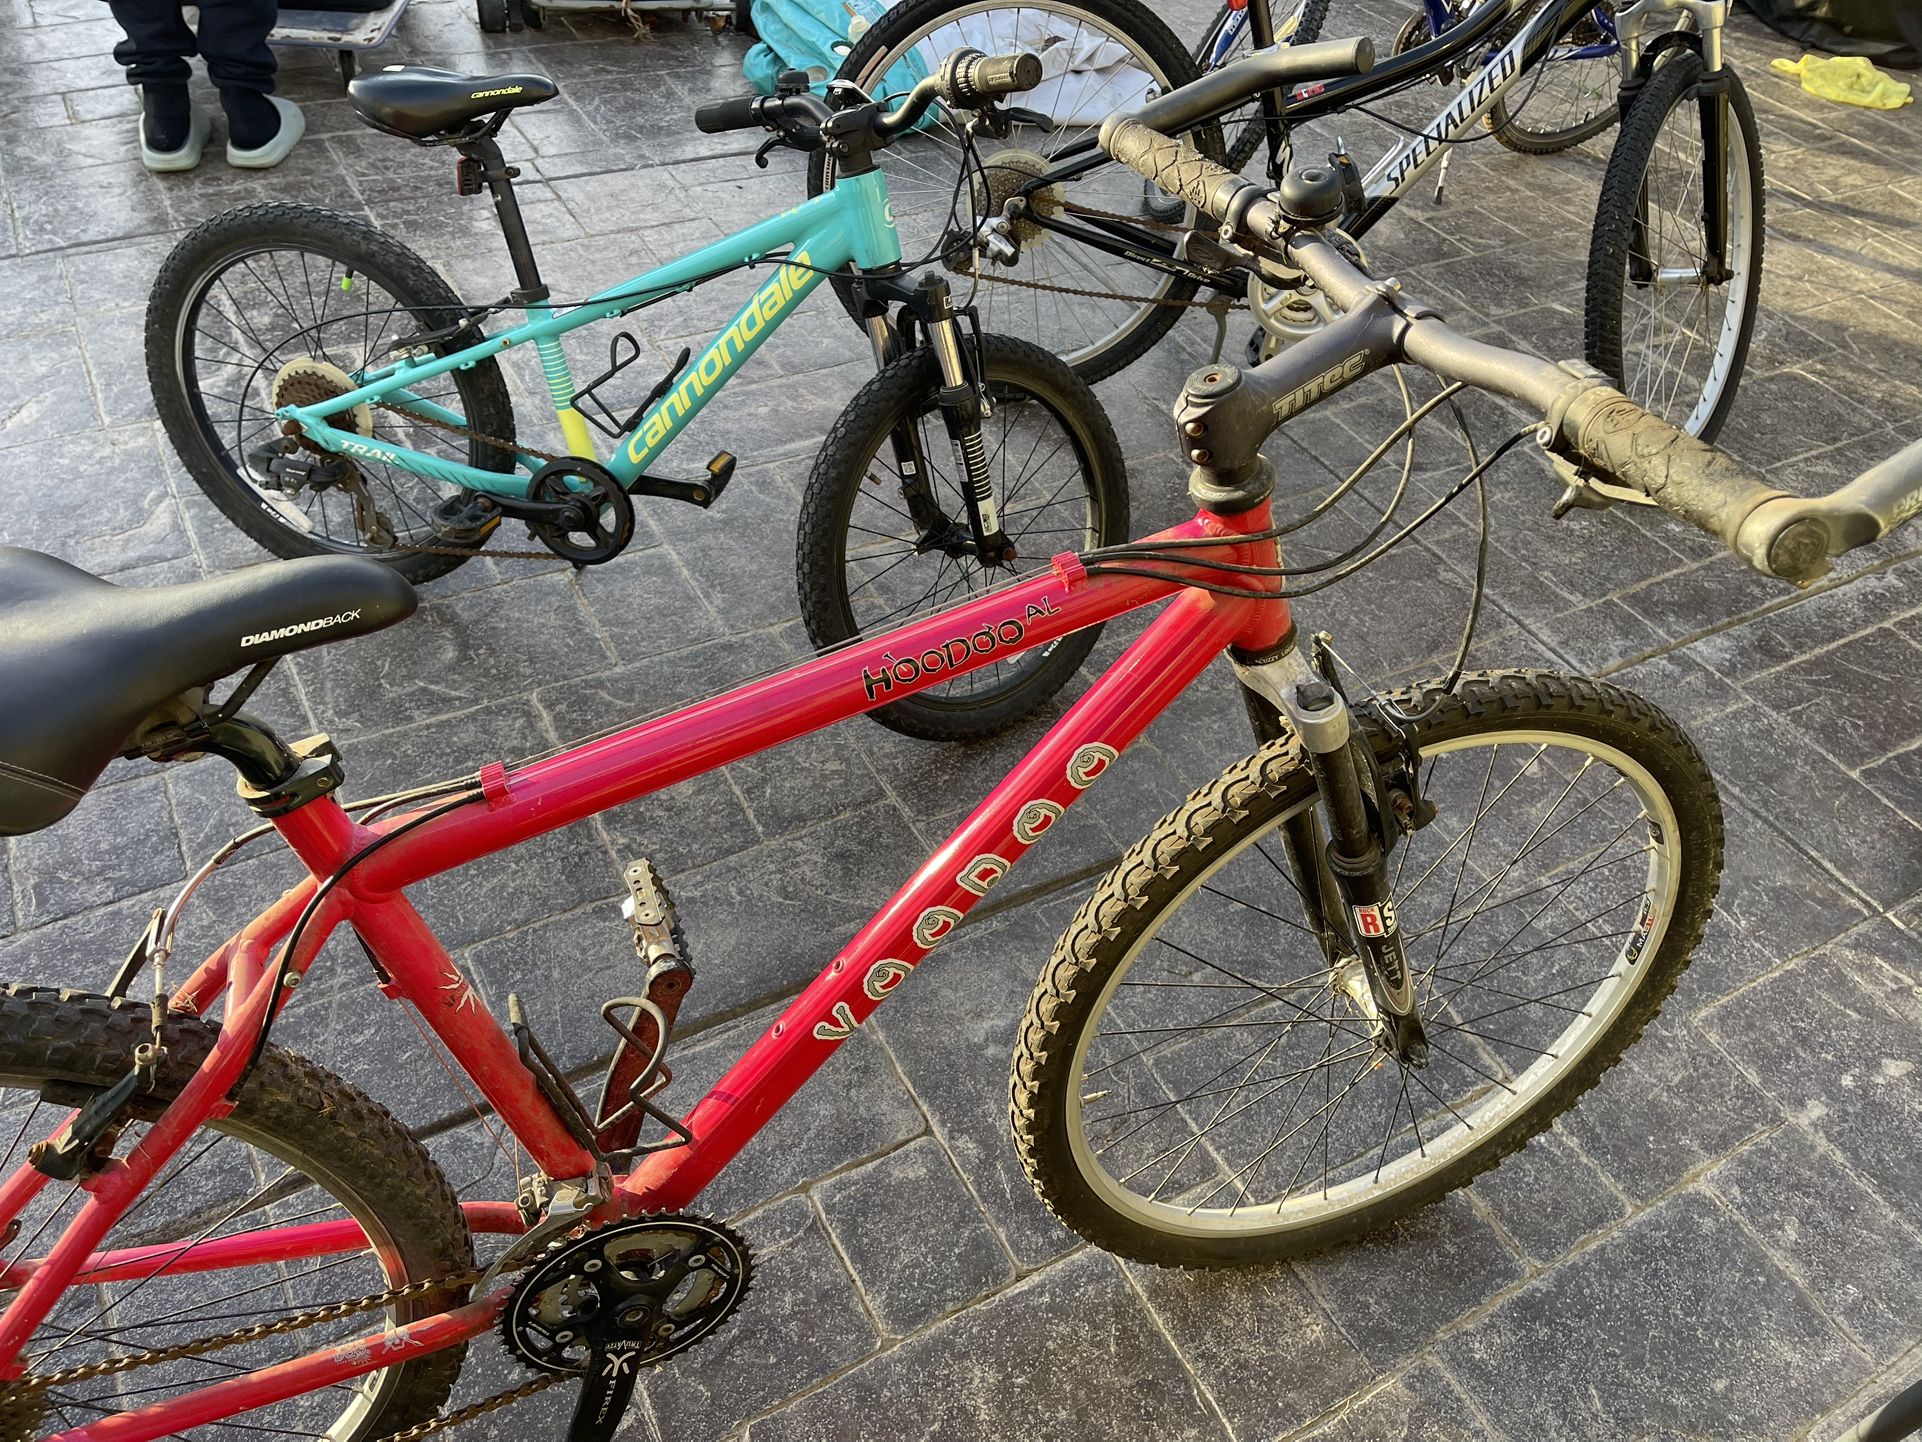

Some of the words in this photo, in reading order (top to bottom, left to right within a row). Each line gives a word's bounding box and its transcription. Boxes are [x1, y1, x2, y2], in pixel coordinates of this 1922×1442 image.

[470, 85, 523, 99] cannondale
[1386, 49, 1516, 196] SPECIALIZED
[627, 250, 815, 465] cannondale
[240, 608, 362, 648] DIAMONDBACK
[861, 618, 1025, 701] HOODOO
[1025, 596, 1062, 625] AL
[813, 741, 1120, 1040] VOODOO
[1381, 944, 1402, 980] JETT
[595, 1379, 617, 1425] FIREX
